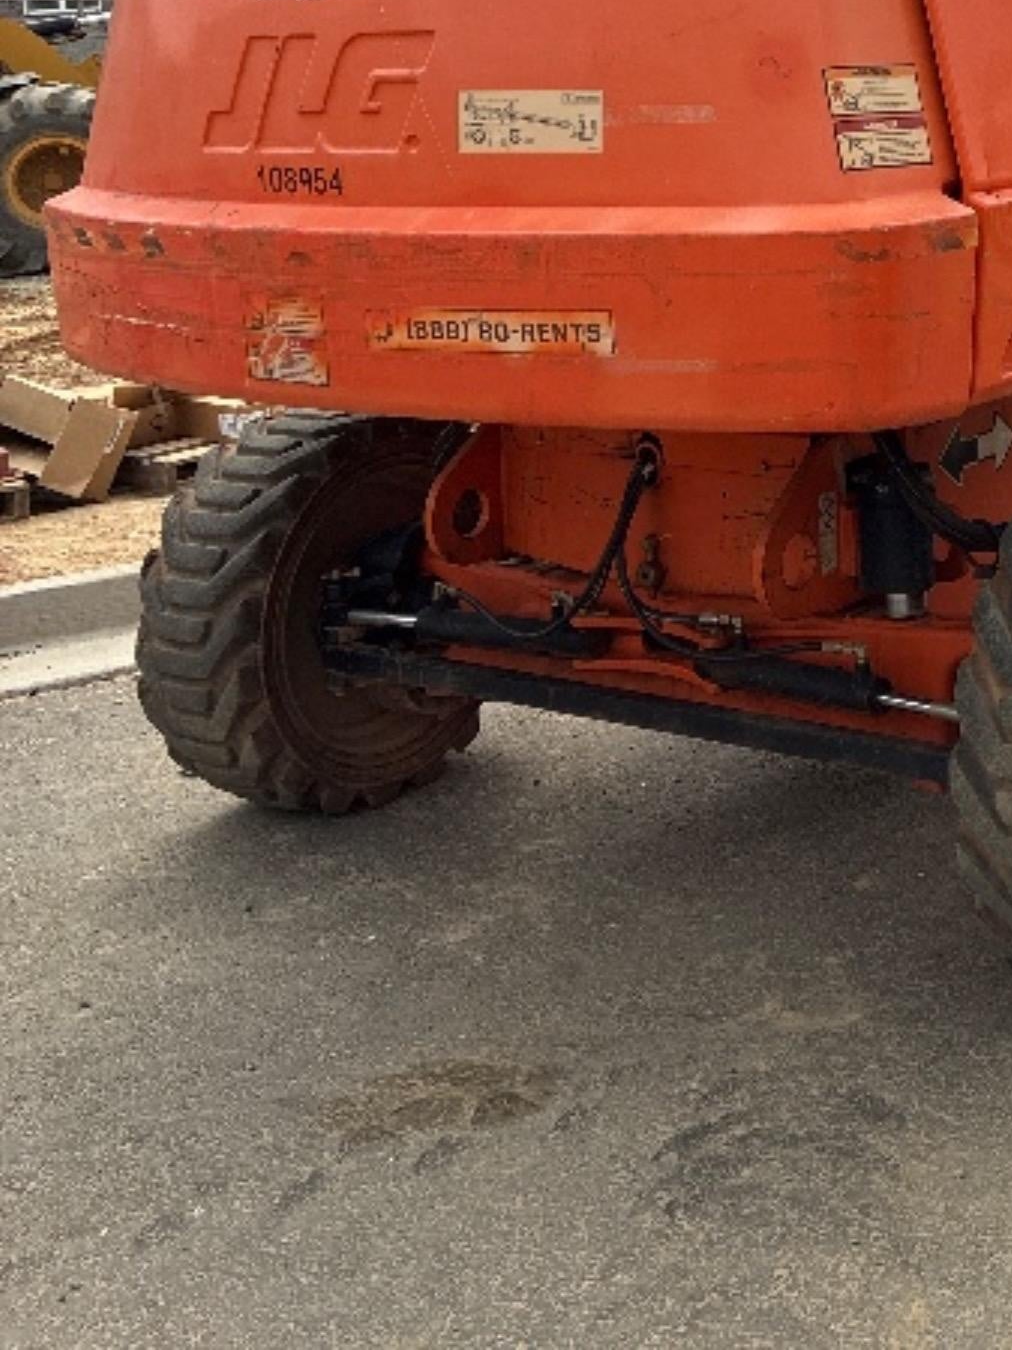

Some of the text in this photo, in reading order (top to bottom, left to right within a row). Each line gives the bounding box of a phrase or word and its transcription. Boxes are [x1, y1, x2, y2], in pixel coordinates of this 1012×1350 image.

[203, 29, 434, 154] JLG
[257, 165, 342, 196] 108954
[468, 318, 602, 344] 80-RENTS
